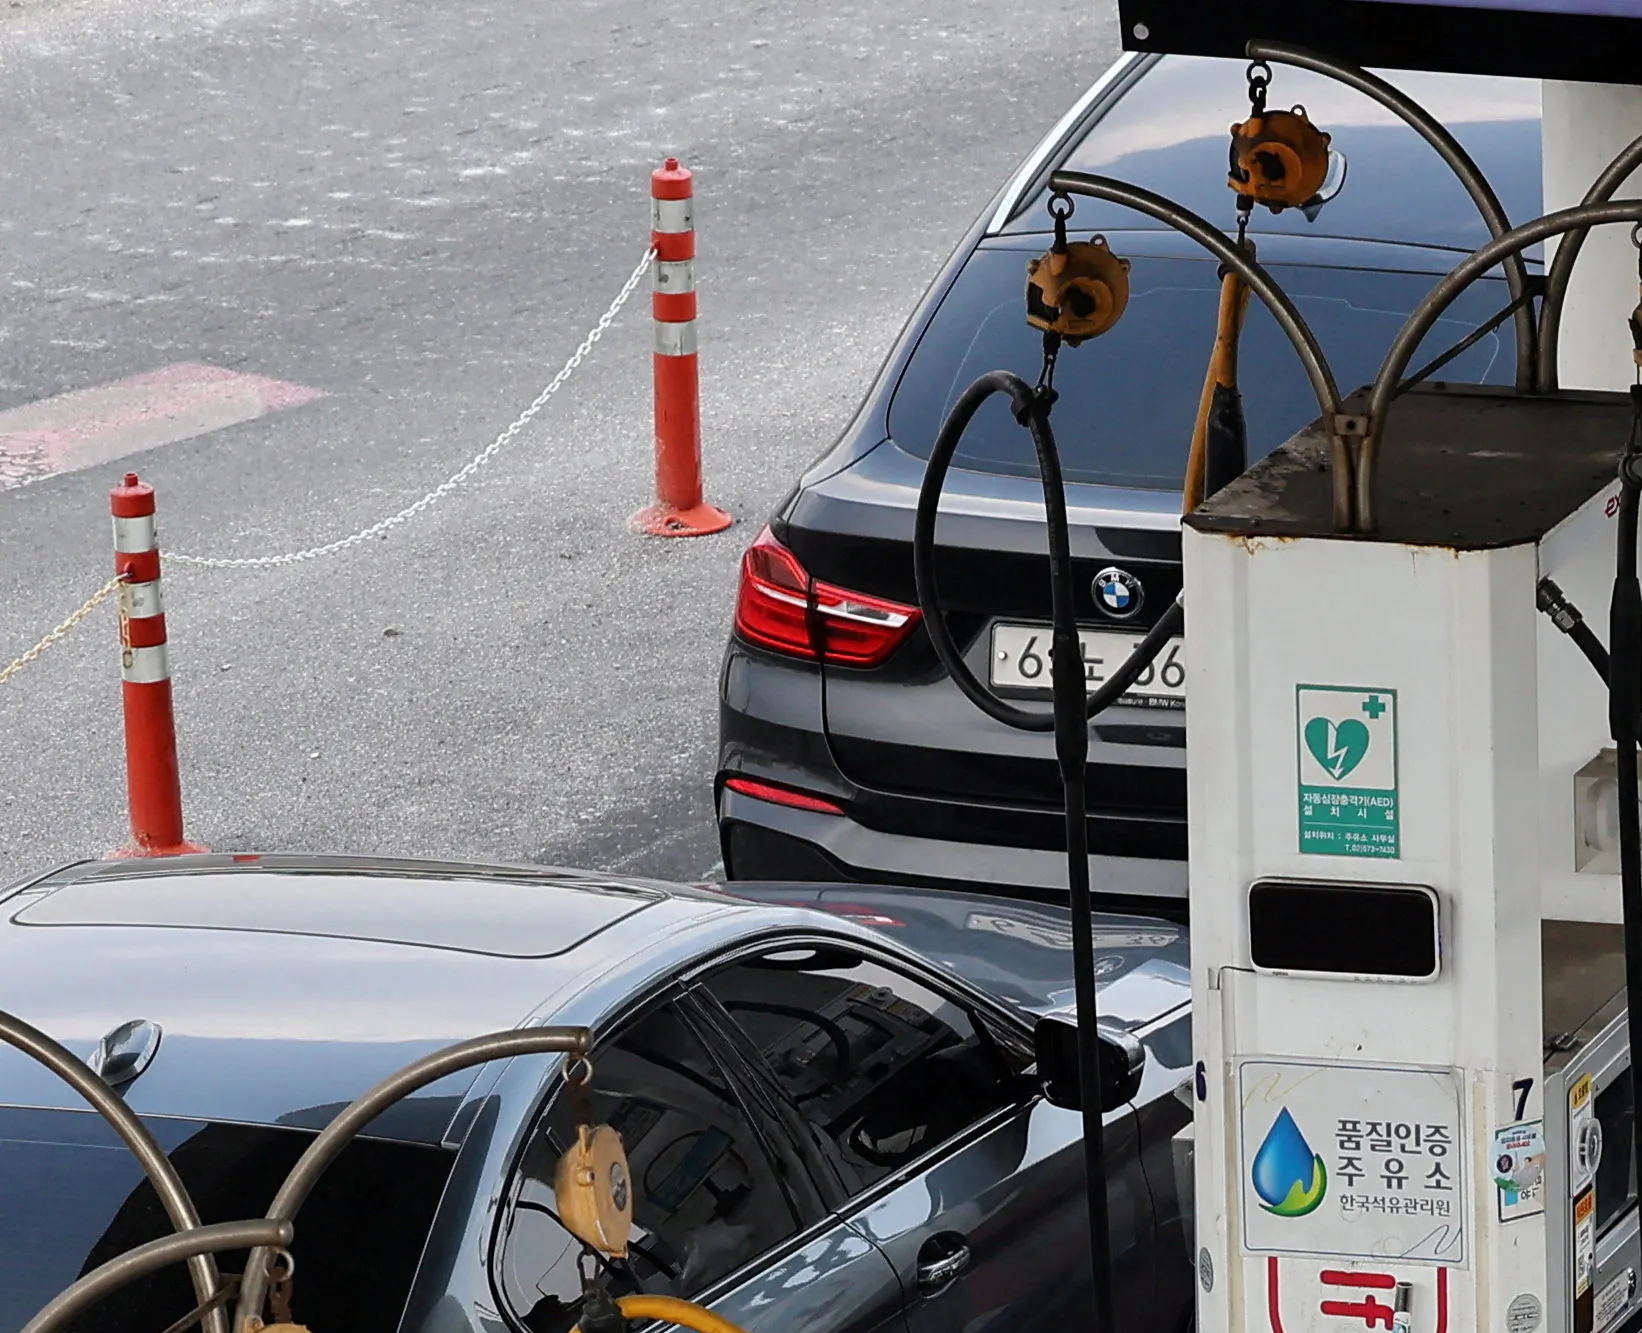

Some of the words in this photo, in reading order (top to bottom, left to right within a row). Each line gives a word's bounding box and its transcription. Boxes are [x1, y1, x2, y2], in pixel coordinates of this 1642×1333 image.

[1512, 1078, 1534, 1121] 7
[1334, 1118, 1452, 1158] 품질인증
[1339, 1193, 1451, 1217] 한국석유관리원
